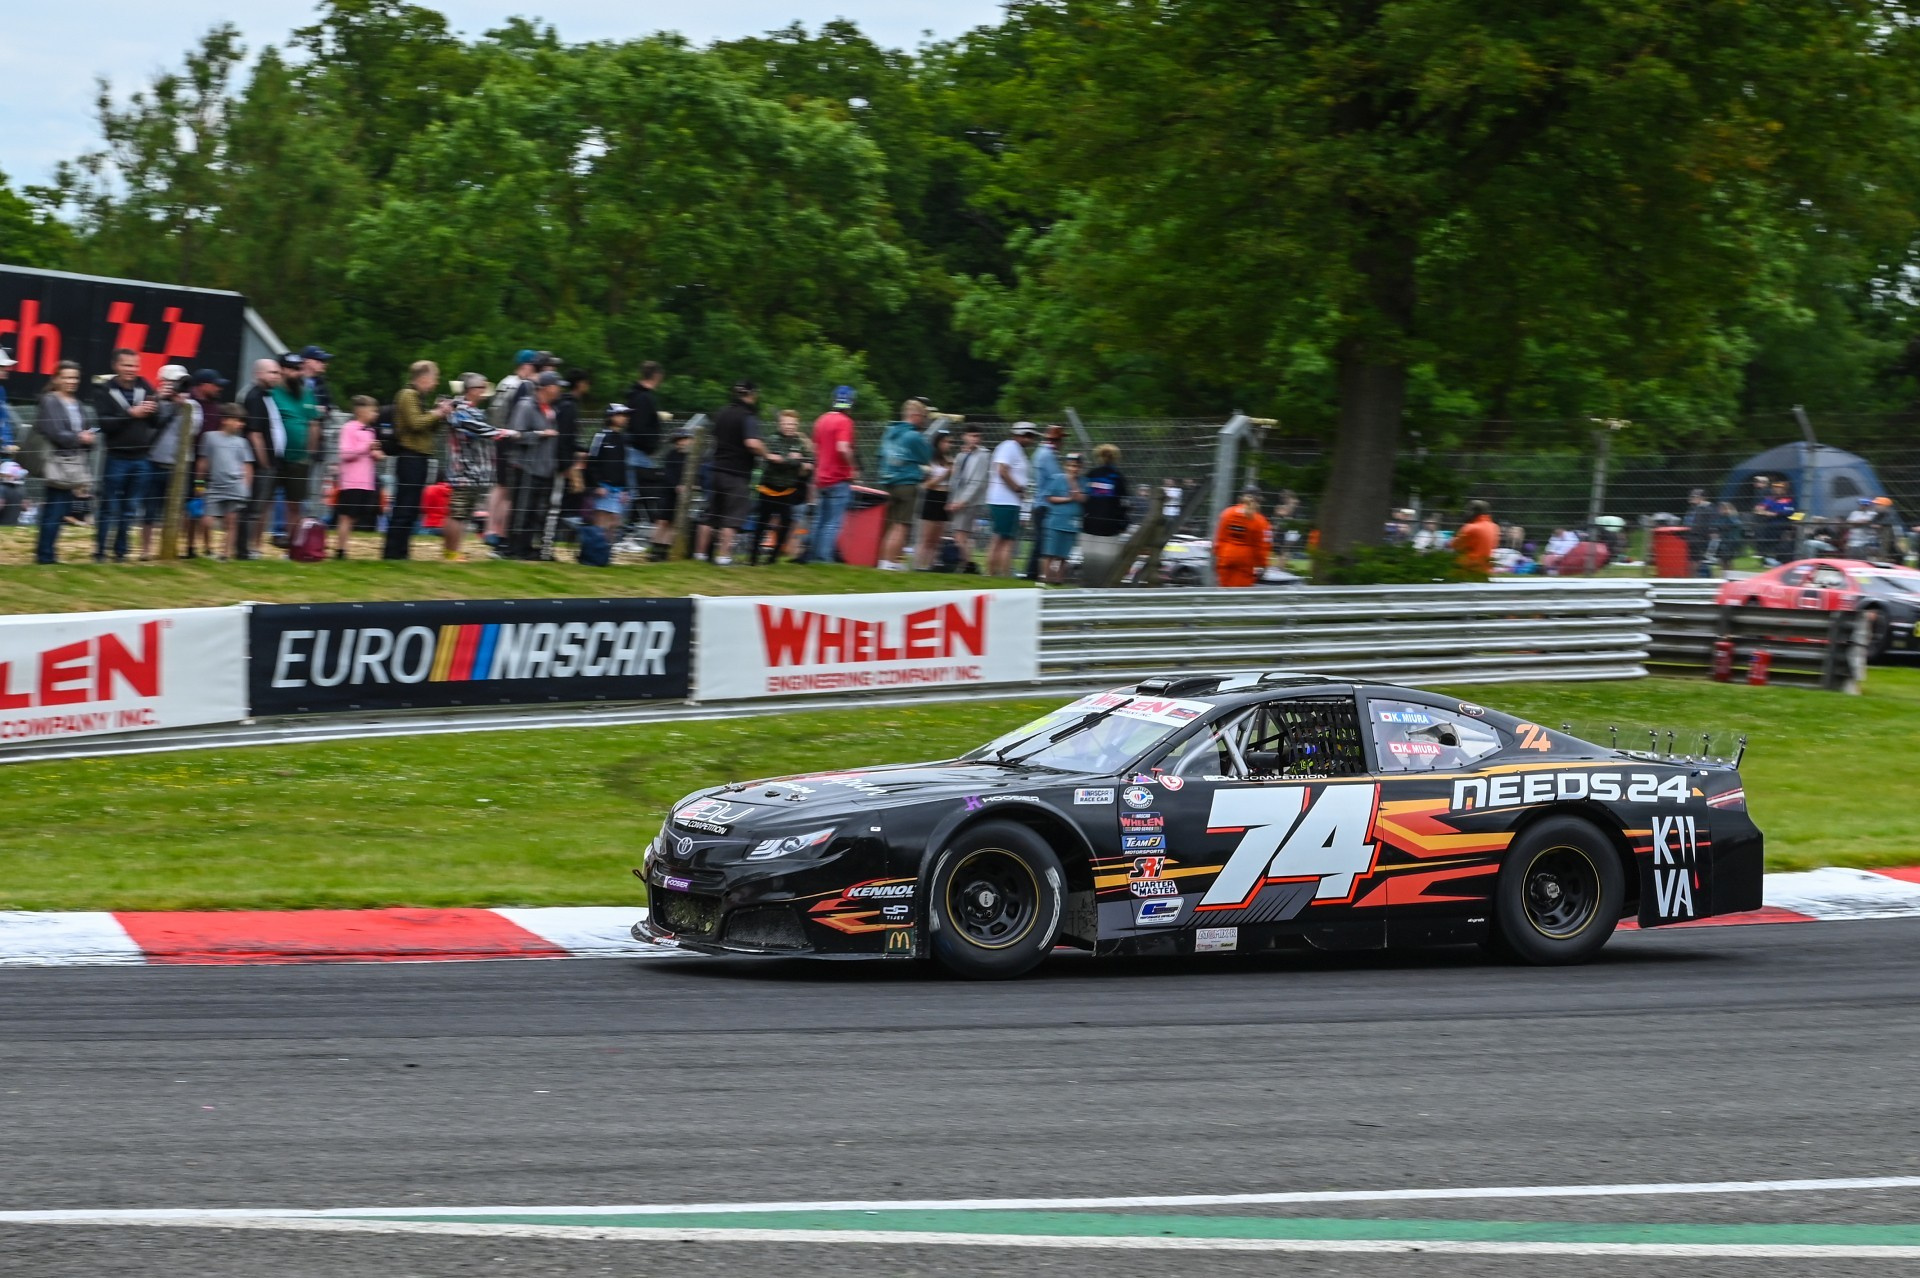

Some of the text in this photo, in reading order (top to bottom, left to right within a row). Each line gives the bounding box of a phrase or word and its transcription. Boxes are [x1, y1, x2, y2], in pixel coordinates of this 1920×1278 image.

[755, 594, 987, 667] WHELEN
[271, 621, 675, 688] EURO NASCAR
[767, 670, 874, 693] ENGINEERING
[877, 667, 949, 686] COMPANY
[1402, 713, 1429, 724] MIURA
[1412, 744, 1439, 754] MIURA
[688, 820, 728, 834] COMPETITION
[1120, 816, 1164, 827] WHELEN
[1197, 784, 1378, 907] 74
[847, 885, 914, 897] KENNOL
[1132, 880, 1175, 891] QUARTER
[1139, 887, 1176, 896] MASTER
